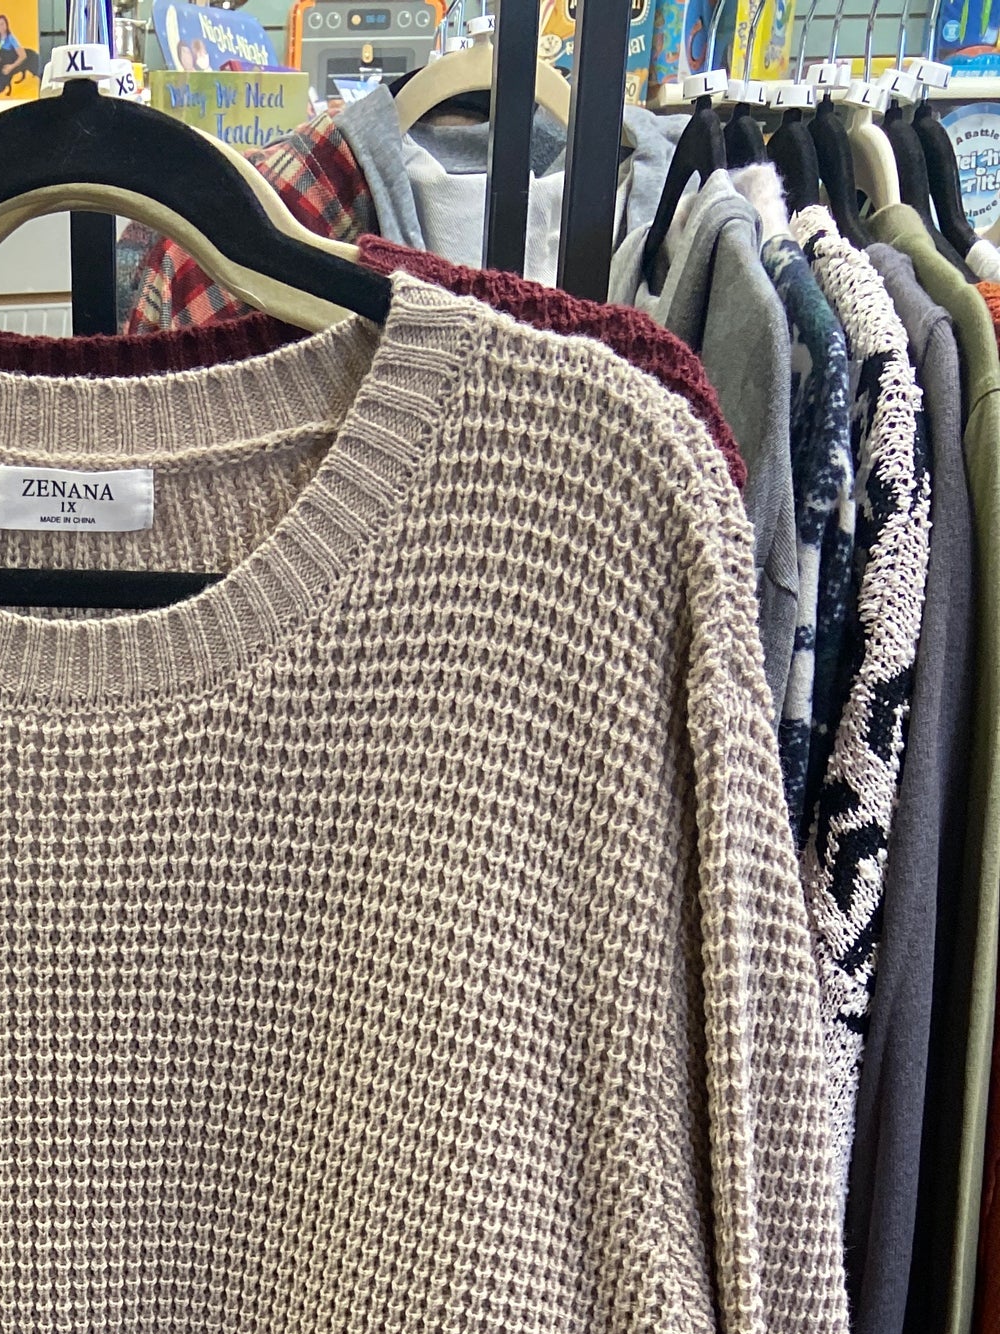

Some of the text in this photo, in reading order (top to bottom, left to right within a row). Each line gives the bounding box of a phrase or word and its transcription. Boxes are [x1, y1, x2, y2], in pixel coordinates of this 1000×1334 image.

[66, 50, 93, 72] XL
[818, 69, 827, 83] L
[917, 65, 924, 81] L
[116, 73, 135, 96] XS
[704, 78, 714, 92] L
[891, 76, 899, 92] L
[167, 80, 284, 118] Why We Need
[776, 91, 784, 104] L
[862, 88, 870, 103] L
[22, 479, 115, 501] ZENANA
[40, 516, 62, 524] MADE
[63, 516, 72, 524] IN
